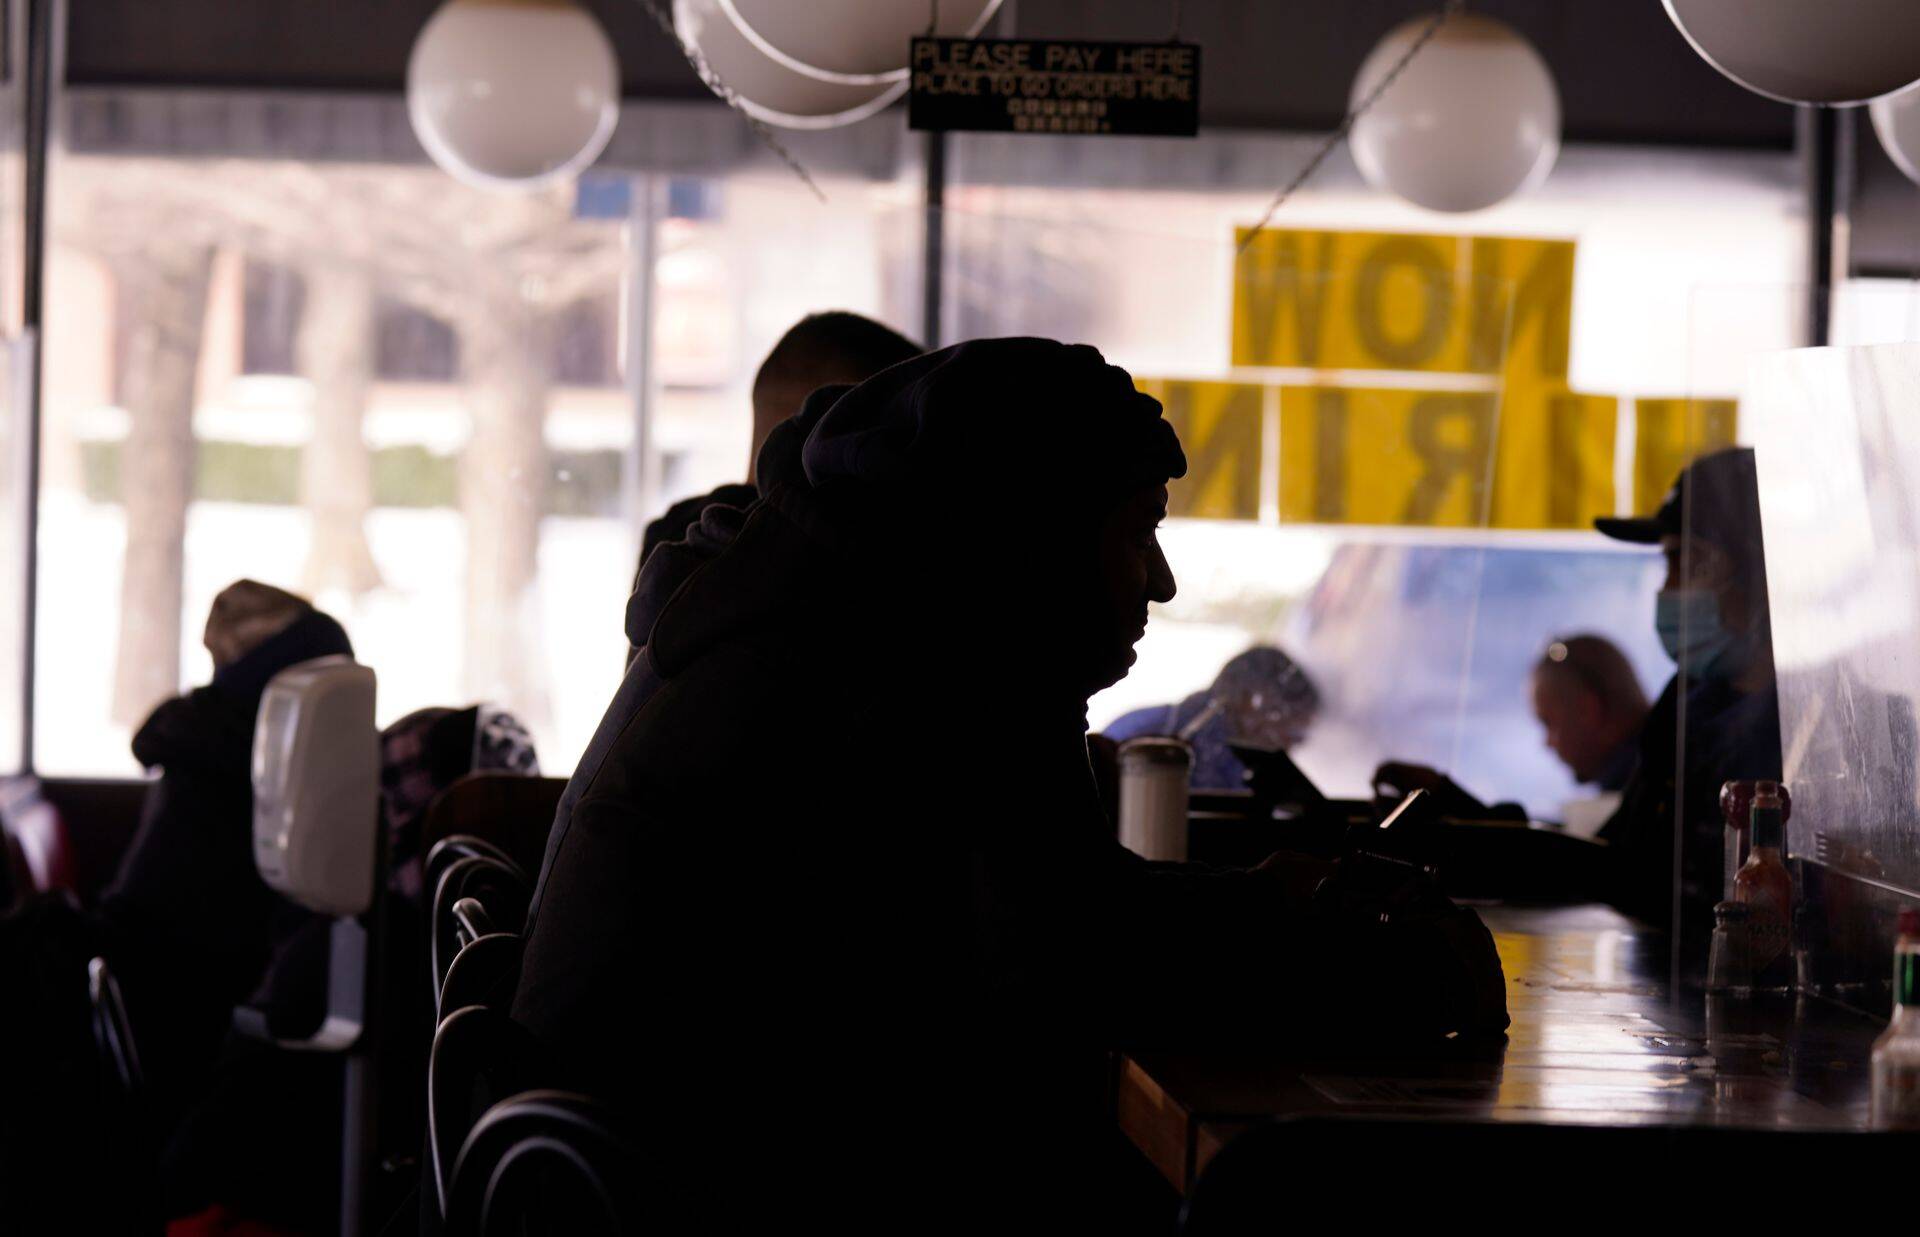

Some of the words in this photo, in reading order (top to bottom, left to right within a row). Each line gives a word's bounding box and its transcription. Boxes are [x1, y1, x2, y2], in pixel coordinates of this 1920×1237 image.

[913, 43, 1031, 70] PLEASE
[1044, 45, 1102, 72] PAY
[1116, 47, 1193, 75] HERE
[913, 71, 981, 96] PLACE
[988, 72, 1015, 96] TO
[1019, 73, 1050, 98] GO
[1054, 74, 1135, 99] ORDERS
[1140, 76, 1192, 101] HERE
